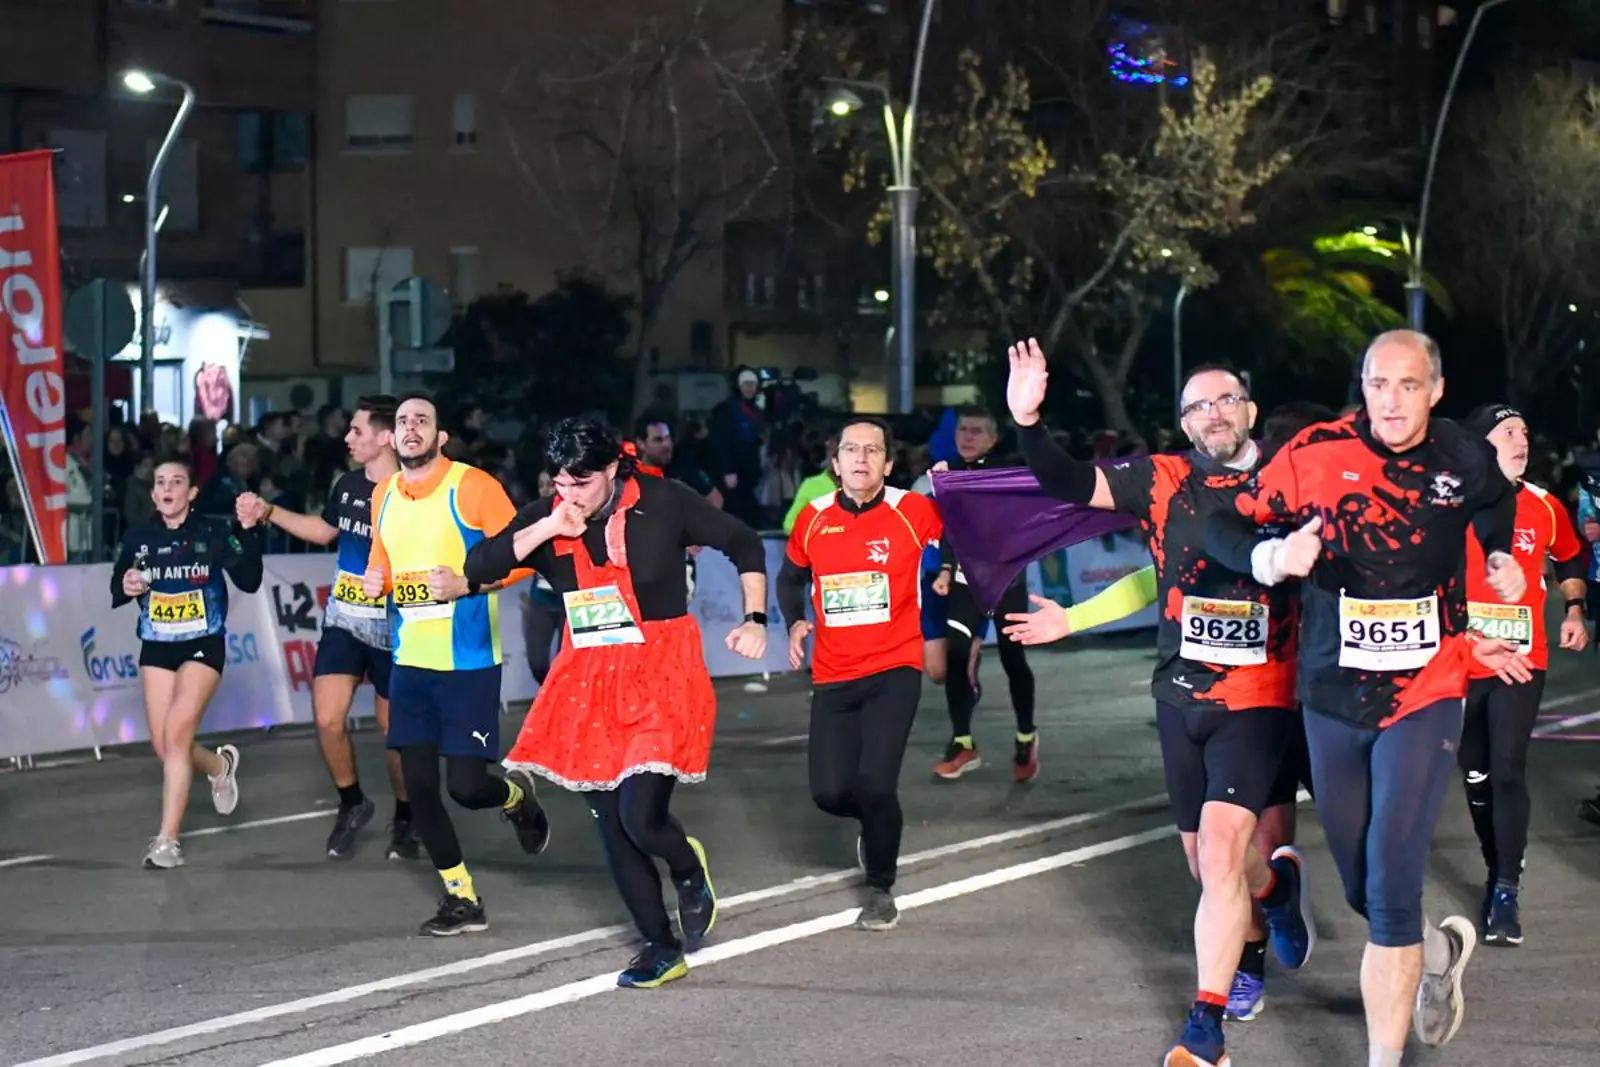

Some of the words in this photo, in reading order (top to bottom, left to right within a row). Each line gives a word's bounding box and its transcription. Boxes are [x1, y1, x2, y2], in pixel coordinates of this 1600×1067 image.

[164, 562, 209, 579] ANTÓN
[153, 602, 199, 619] 4473
[1190, 616, 1260, 640] 9628
[1348, 619, 1426, 644] 9651
